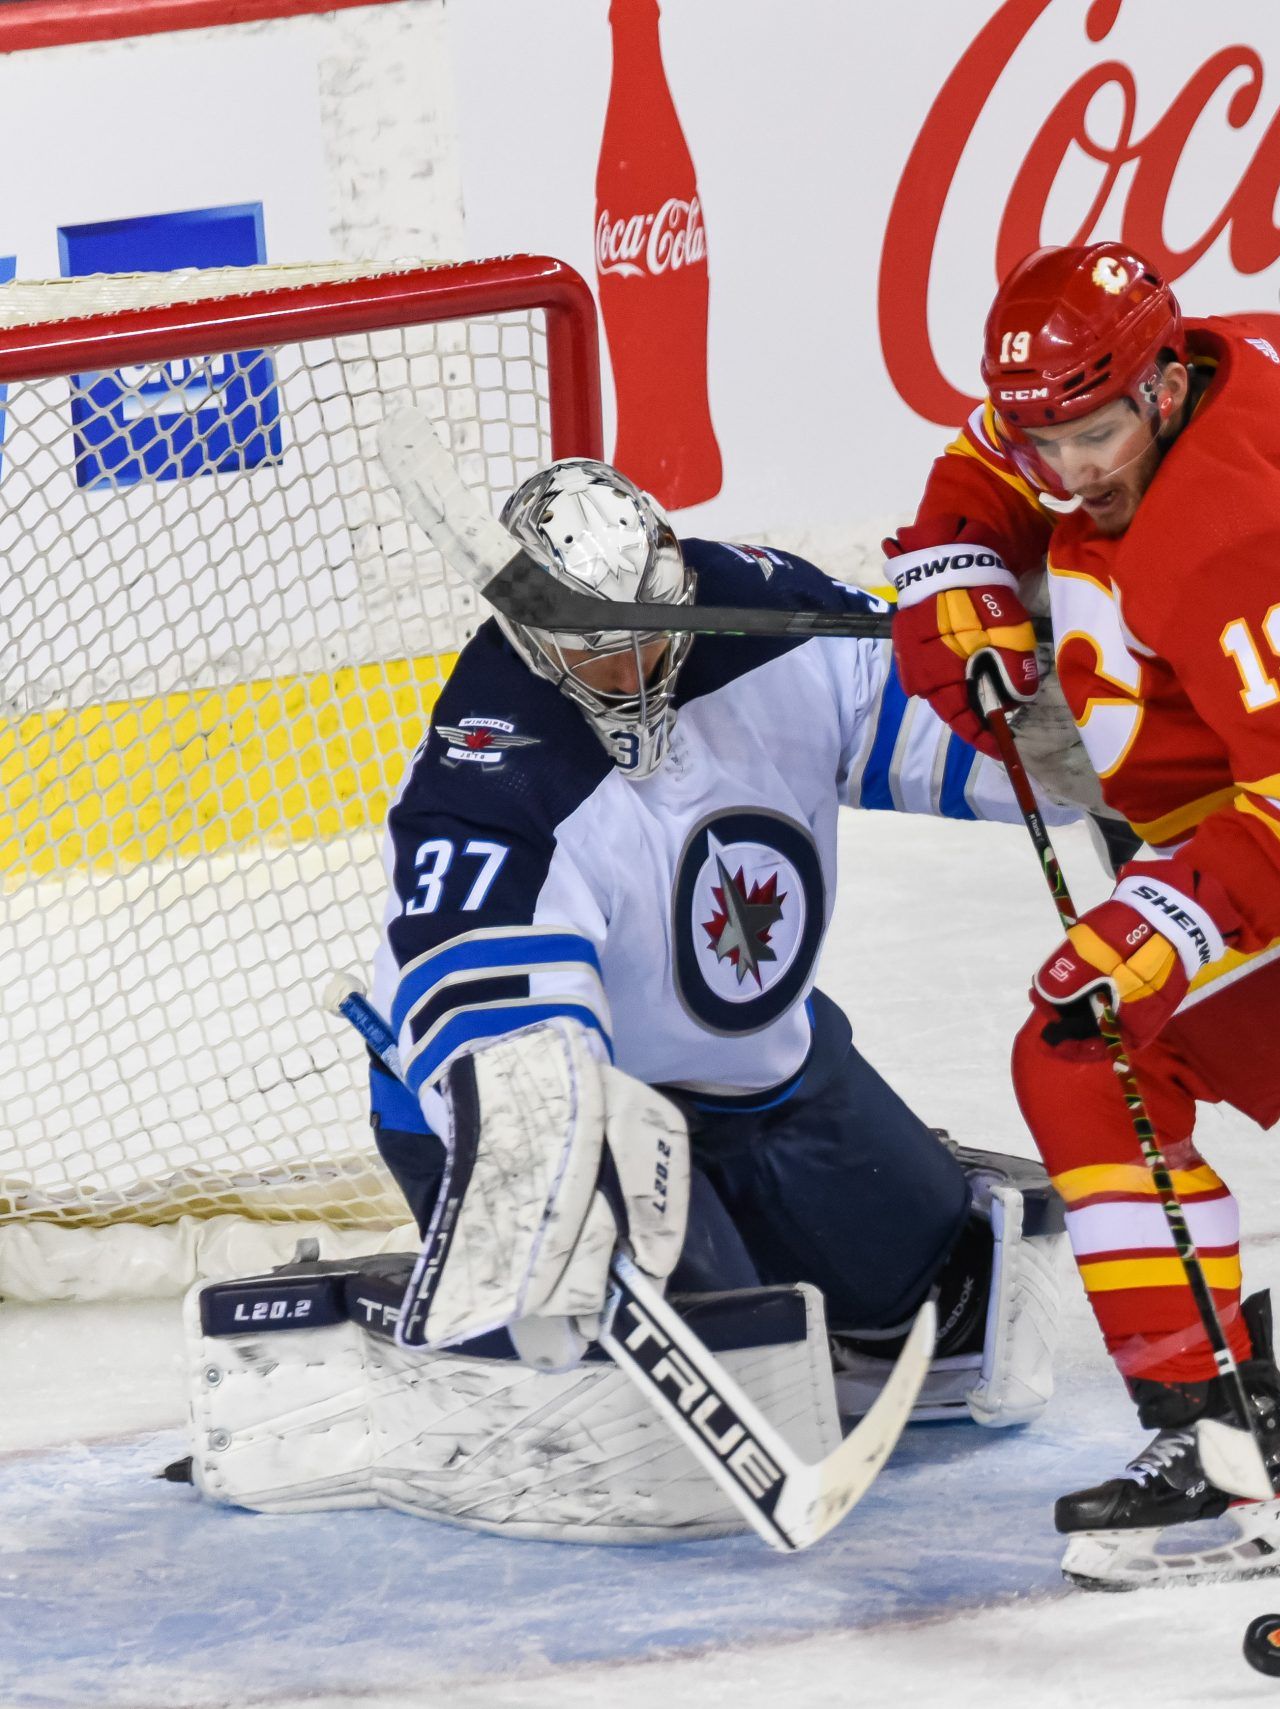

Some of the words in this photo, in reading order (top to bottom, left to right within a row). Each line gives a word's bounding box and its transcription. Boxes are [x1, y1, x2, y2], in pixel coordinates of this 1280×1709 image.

[597, 197, 707, 278] Coca-Cola
[1000, 331, 1031, 363] 19
[1001, 388, 1048, 401] CCM
[405, 838, 509, 915] 37
[653, 1139, 671, 1214] L20.2
[233, 1299, 312, 1321] L20.2
[356, 1297, 401, 1326] TR
[624, 1301, 781, 1499] TRUE
